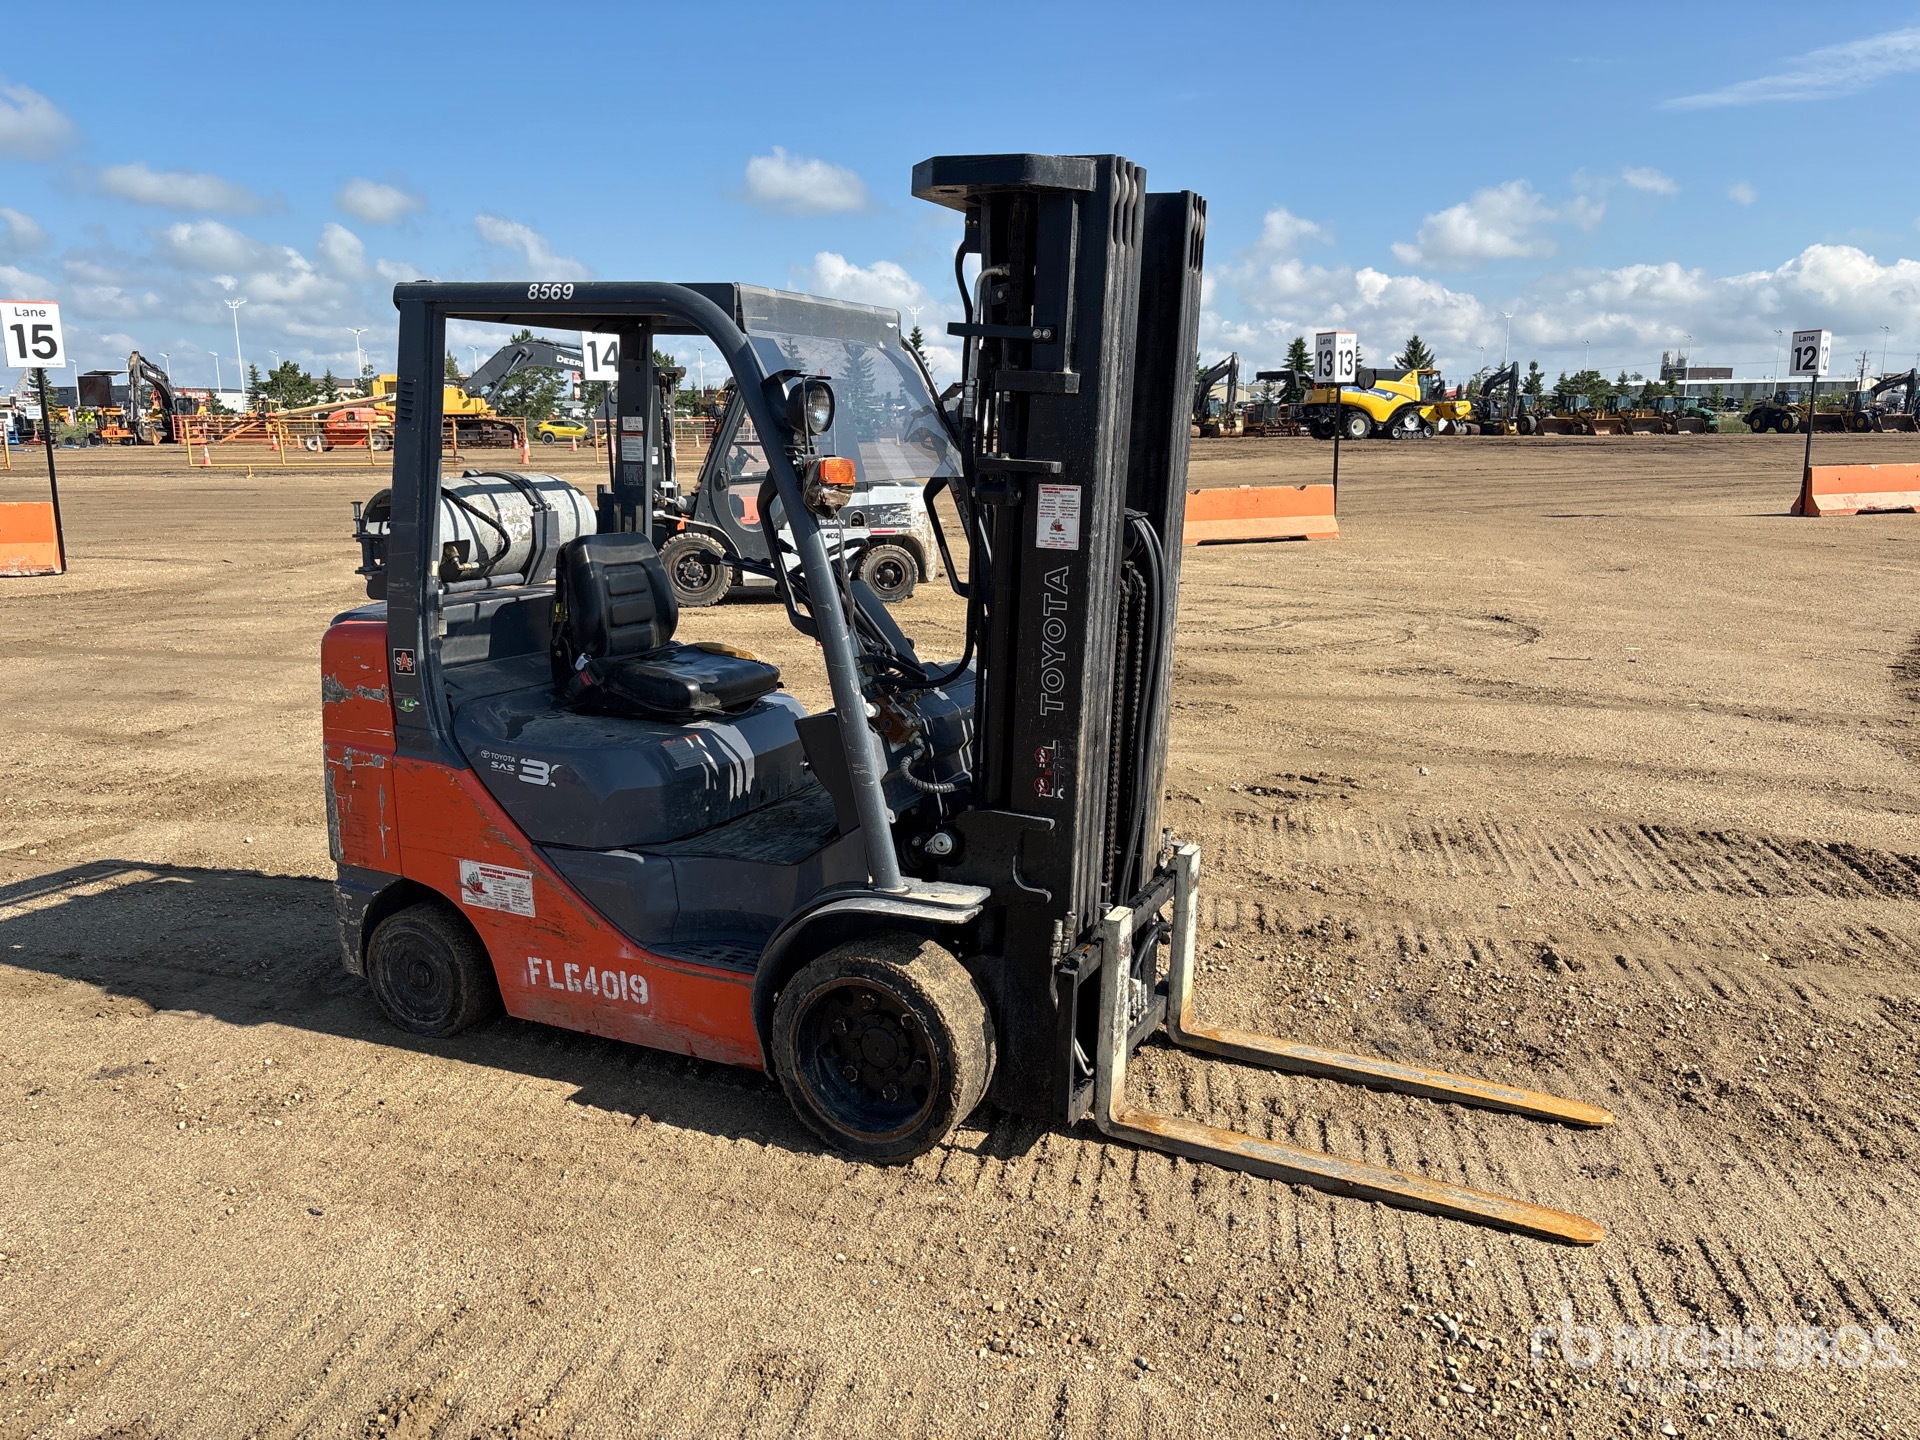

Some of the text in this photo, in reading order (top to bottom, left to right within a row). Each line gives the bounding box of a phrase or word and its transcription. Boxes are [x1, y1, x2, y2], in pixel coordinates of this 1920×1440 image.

[527, 283, 574, 300] 8569
[14, 306, 46, 317] Lane
[10, 323, 58, 359] 15
[1320, 337, 1332, 345] Lane
[586, 340, 619, 372] 14
[1317, 349, 1334, 377] 13
[1338, 349, 1354, 376] 13
[1794, 346, 1816, 370] 12
[1040, 565, 1069, 716] TOYOTA
[490, 761, 516, 772] SAS
[491, 752, 516, 764] TOYOTA
